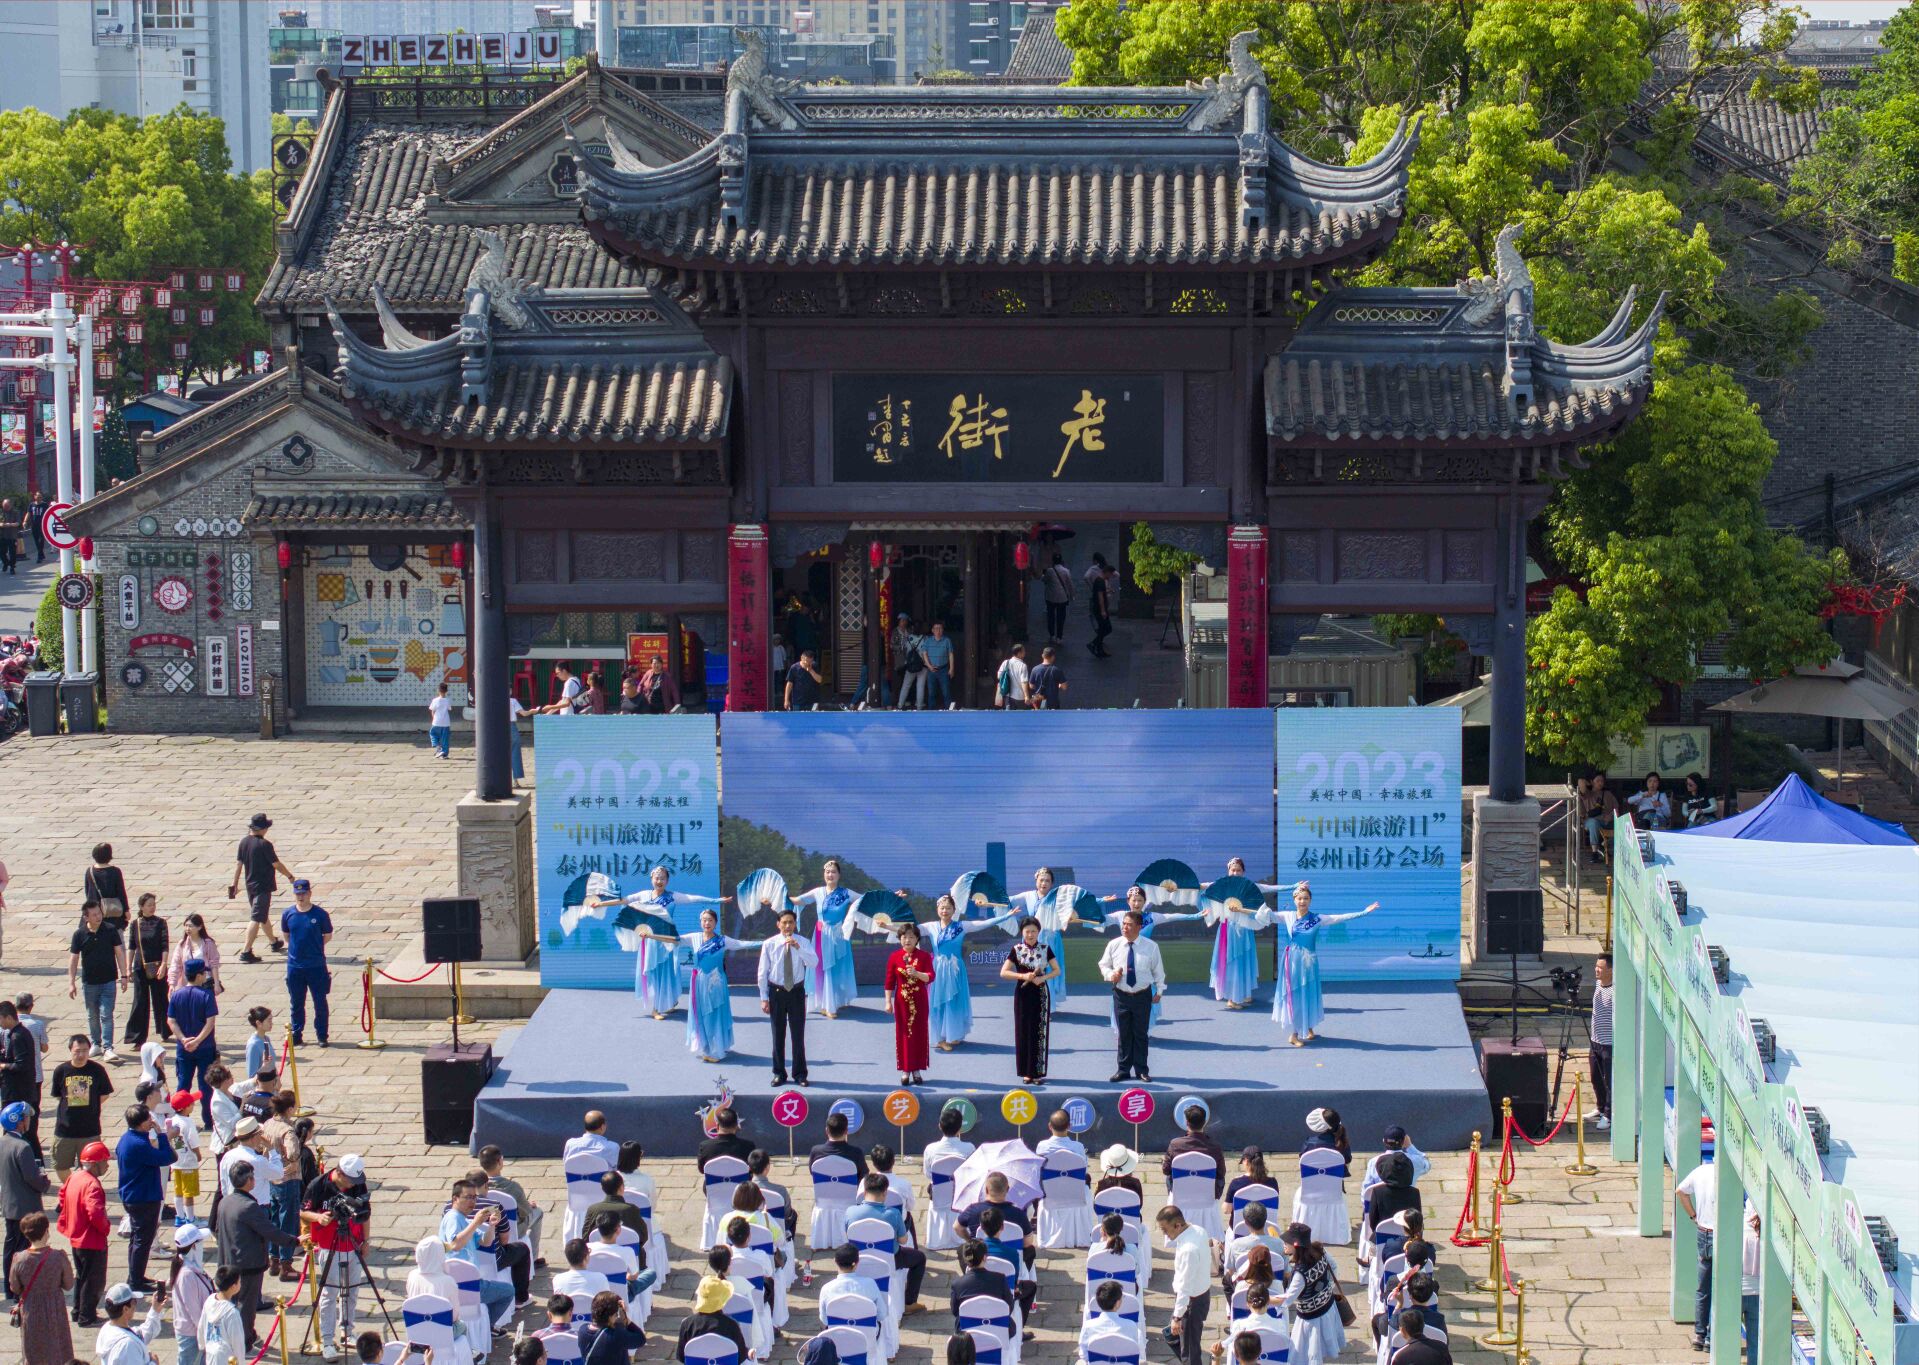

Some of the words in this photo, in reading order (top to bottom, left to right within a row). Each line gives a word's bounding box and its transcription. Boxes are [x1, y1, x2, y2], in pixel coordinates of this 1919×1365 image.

[344, 36, 558, 61] ZHEZHEJU
[937, 389, 1107, 479] 老街
[180, 523, 237, 532] 点心面食
[67, 584, 82, 599] 茶
[211, 643, 223, 690] 虾籽拌面
[240, 629, 250, 692] LAOZIHAO
[126, 668, 142, 684] 茶
[553, 758, 702, 804] 2023
[1296, 751, 1447, 797] 2023
[1296, 845, 1446, 871] 泰州市分会场
[781, 1098, 800, 1121] 文
[892, 1097, 911, 1120] 艺
[1010, 1096, 1028, 1120] 共
[1127, 1093, 1146, 1118] 享
